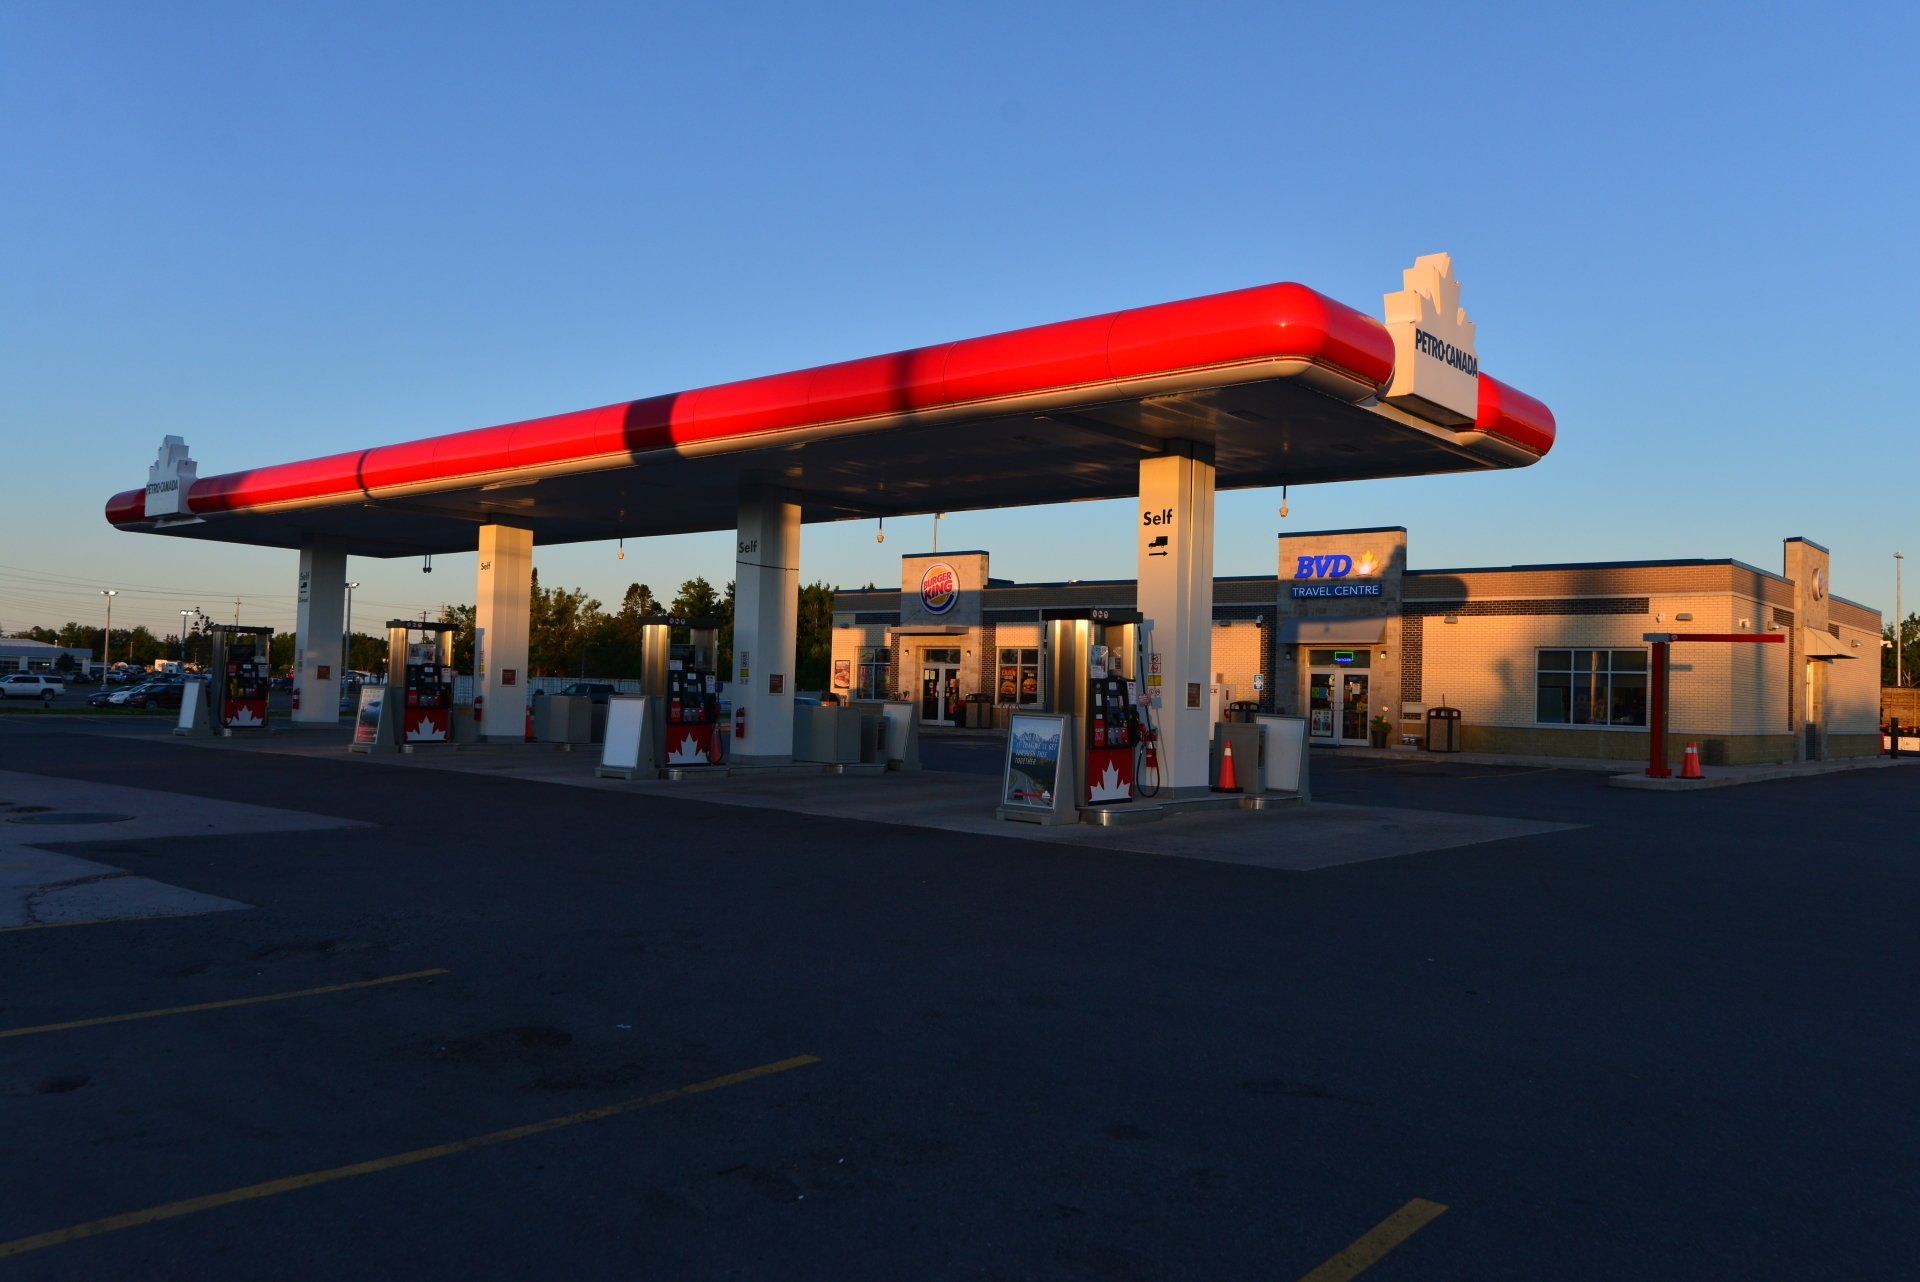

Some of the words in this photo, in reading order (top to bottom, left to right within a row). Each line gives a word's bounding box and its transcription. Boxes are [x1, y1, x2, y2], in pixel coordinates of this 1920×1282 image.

[1143, 508, 1173, 526] Self
[739, 540, 758, 553] Self
[480, 561, 491, 571] Self
[1294, 554, 1353, 579] BVD
[923, 571, 952, 591] BURGER
[924, 580, 953, 601] KING
[1291, 586, 1332, 597] TRAVEL
[1334, 585, 1379, 596] CENTRE
